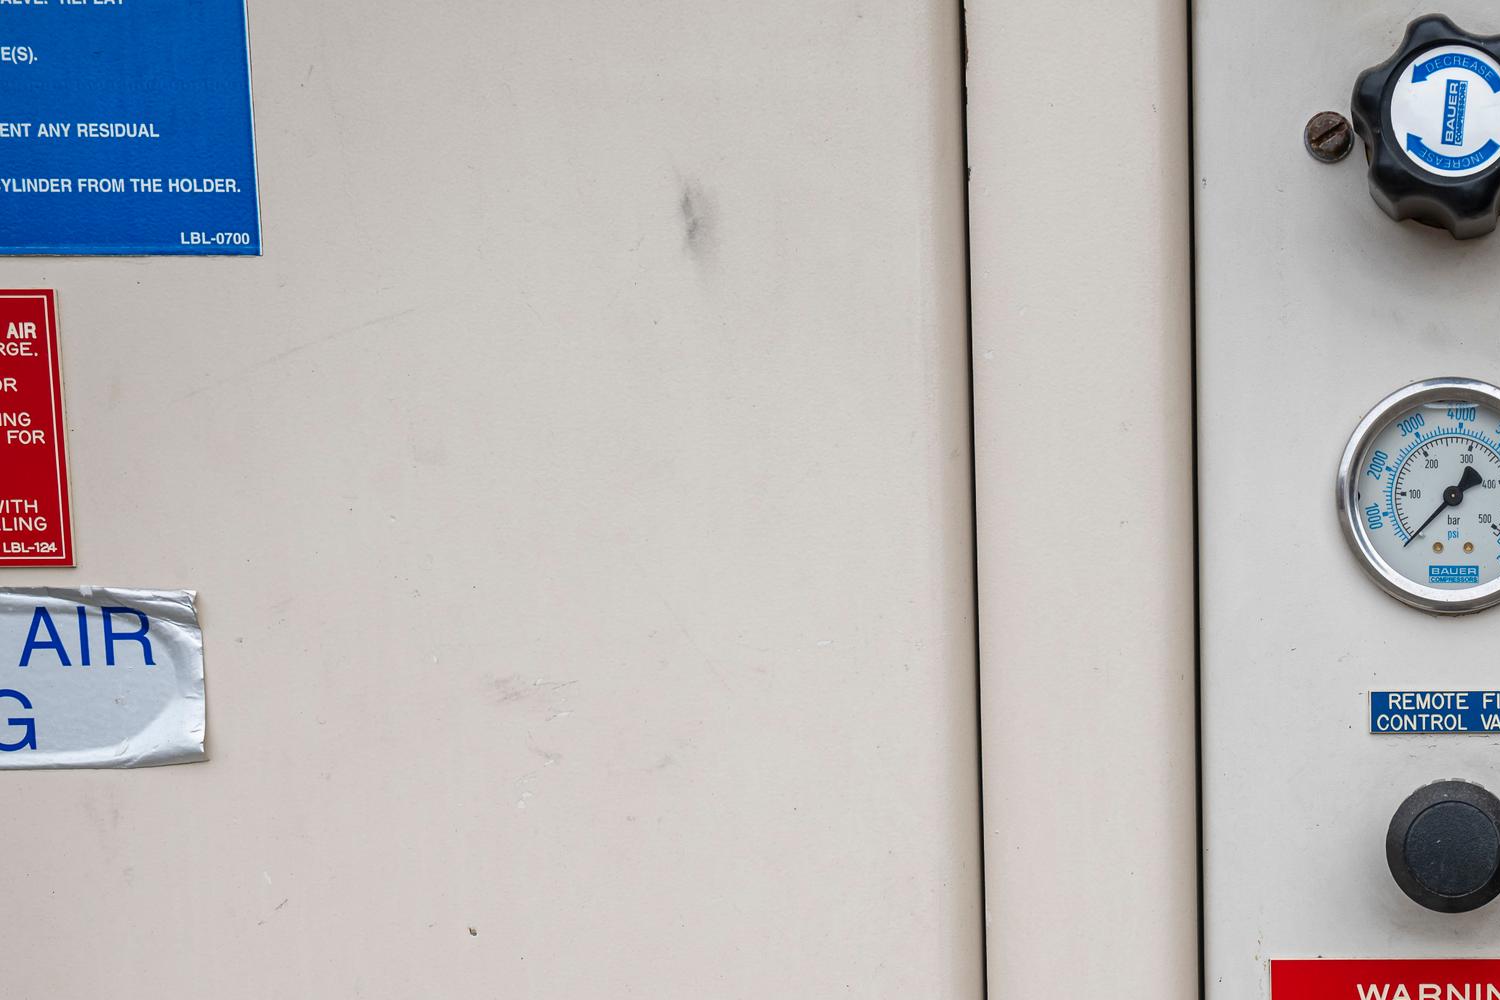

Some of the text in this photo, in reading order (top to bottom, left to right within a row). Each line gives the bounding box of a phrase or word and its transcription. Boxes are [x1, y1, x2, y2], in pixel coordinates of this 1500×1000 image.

[1425, 55, 1494, 81] DECREASE
[1445, 82, 1459, 142] BAUER
[37, 123, 71, 138] ANY
[77, 123, 160, 138] RESIDUAL
[1418, 149, 1484, 168] INCREASE
[0, 178, 241, 193] YLINDER FROM THE HOLDER.
[180, 232, 250, 245] LBL-0700
[7, 322, 37, 339] AIR
[1446, 405, 1476, 423] 4000
[1397, 413, 1425, 437] 3000
[7, 430, 45, 444] FOR
[1367, 450, 1389, 480] 2000
[1425, 459, 1439, 469] 200
[1460, 454, 1474, 464] 300
[1482, 480, 1496, 489] 400
[1409, 490, 1421, 499] 100
[0, 500, 38, 514] ITH
[1365, 503, 1383, 530] 1000
[1447, 515, 1460, 526] bar
[1478, 514, 1492, 524] 500
[0, 517, 47, 531] LING
[1447, 529, 1460, 539] psi
[3, 542, 57, 553] LBL-124
[1431, 567, 1477, 575] BAUER
[19, 606, 156, 667] AIR
[1388, 693, 1469, 710] REMOTE
[1376, 714, 1468, 730] CONTROL
